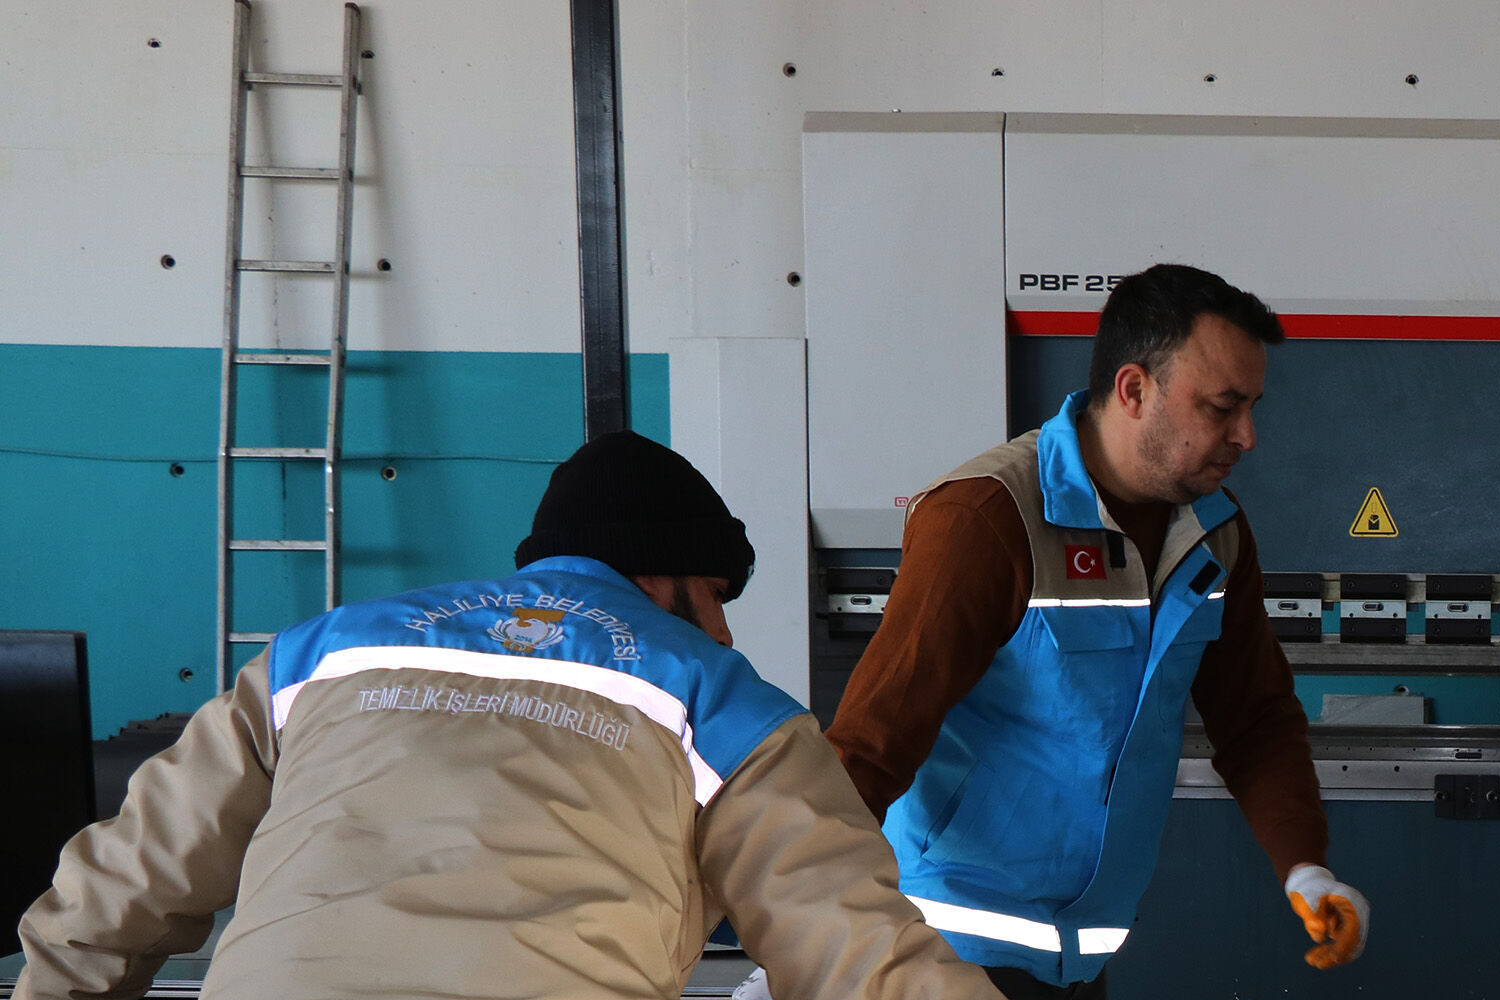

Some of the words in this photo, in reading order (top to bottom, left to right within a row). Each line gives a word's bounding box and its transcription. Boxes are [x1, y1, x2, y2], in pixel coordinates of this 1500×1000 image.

[1019, 273, 1079, 291] PBF
[404, 594, 524, 632] HALİLİYE
[535, 594, 642, 661] BELEDİYESİ
[509, 695, 632, 751] MÜDÜRLÜĞÜ
